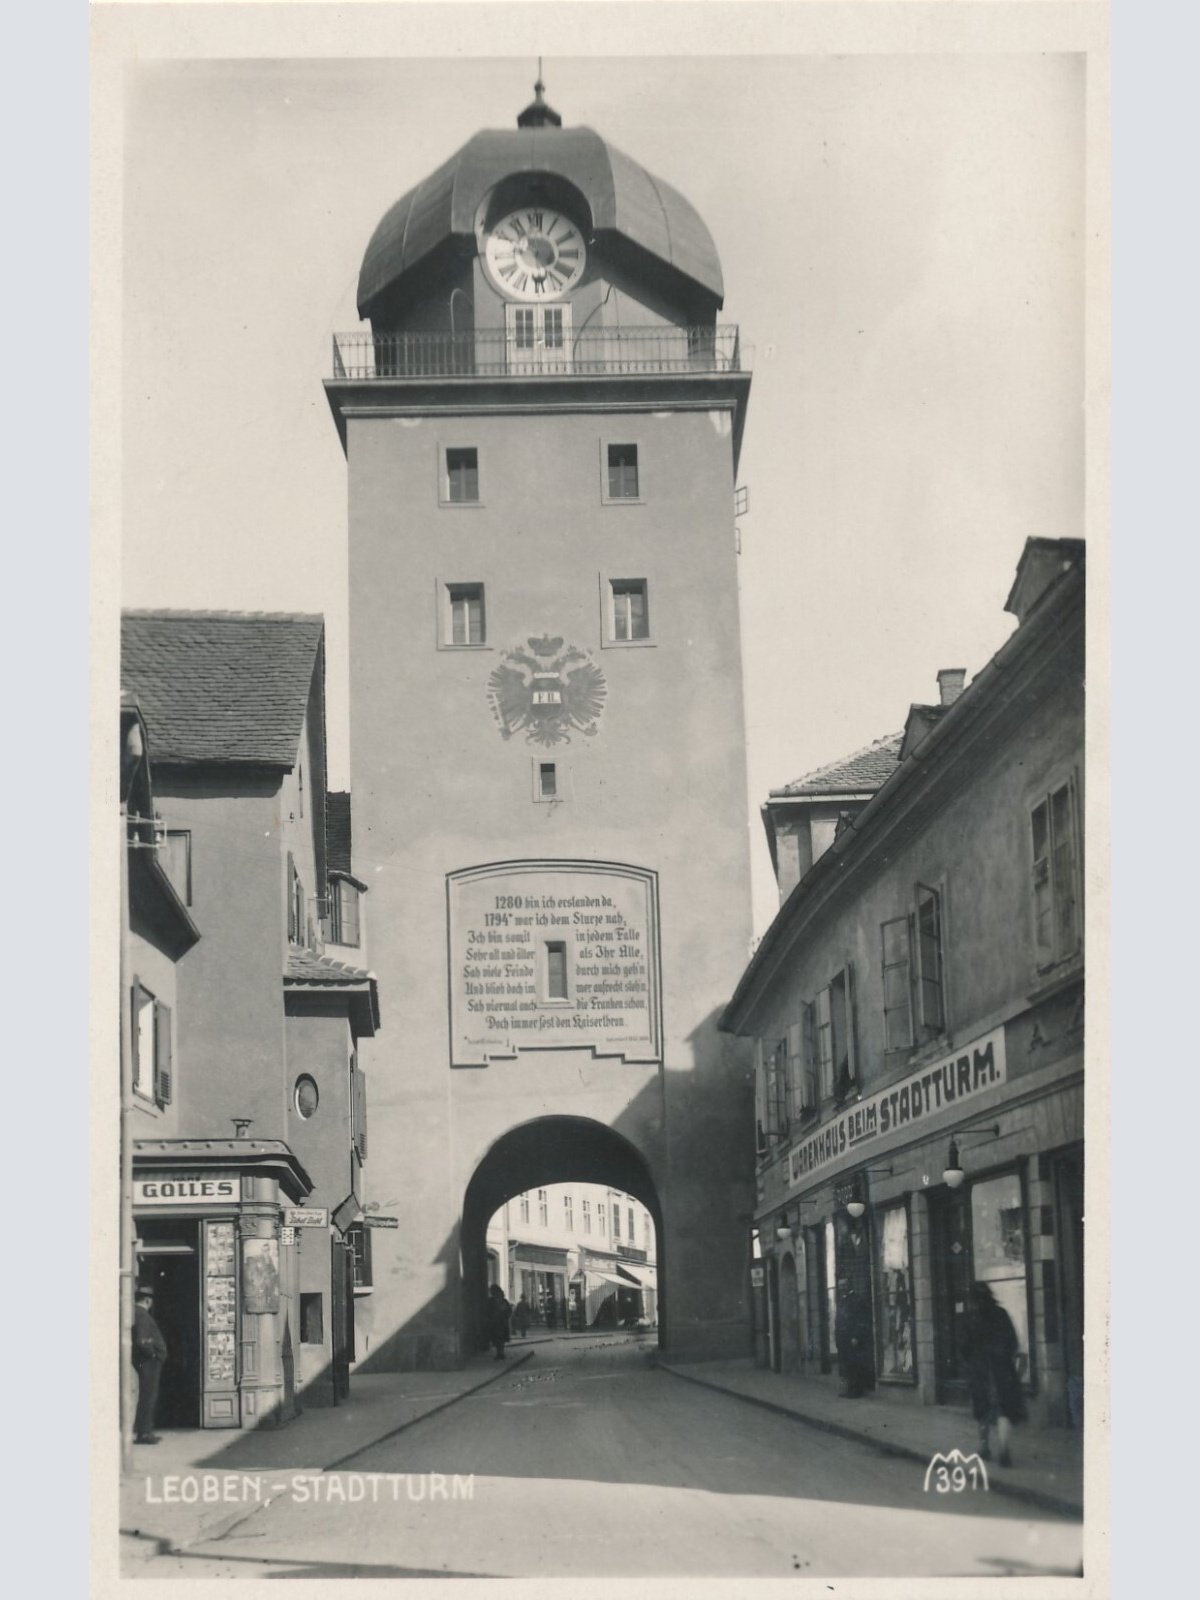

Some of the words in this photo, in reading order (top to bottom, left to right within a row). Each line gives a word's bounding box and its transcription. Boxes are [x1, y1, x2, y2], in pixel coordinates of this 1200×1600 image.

[495, 896, 522, 909] 1280
[525, 896, 540, 909] bin
[542, 895, 556, 909] ich
[535, 913, 549, 927] ich
[551, 913, 570, 925] dem
[573, 911, 603, 926] Sturze
[467, 930, 486, 944] Ich
[488, 930, 503, 943] bin
[505, 929, 531, 943] somit
[575, 929, 585, 941] in
[586, 929, 614, 943] jedem
[614, 927, 640, 941] Falle
[466, 947, 488, 961] Sehr
[501, 948, 516, 960] und
[579, 947, 593, 959] als
[595, 945, 616, 959] Ihr
[463, 964, 480, 978] Sah
[482, 964, 502, 978] viele
[504, 963, 534, 978] Feinde
[576, 963, 599, 976] durch
[601, 963, 621, 976] mich
[465, 981, 484, 995] Und
[506, 982, 524, 995] doch
[467, 999, 485, 1012] Sah
[576, 997, 588, 1010] die
[485, 1015, 509, 1030] Doch
[511, 1015, 538, 1029] immer
[555, 1015, 571, 1028] den
[848, 1103, 877, 1140] BEIM
[142, 1182, 233, 1198] GOLLES
